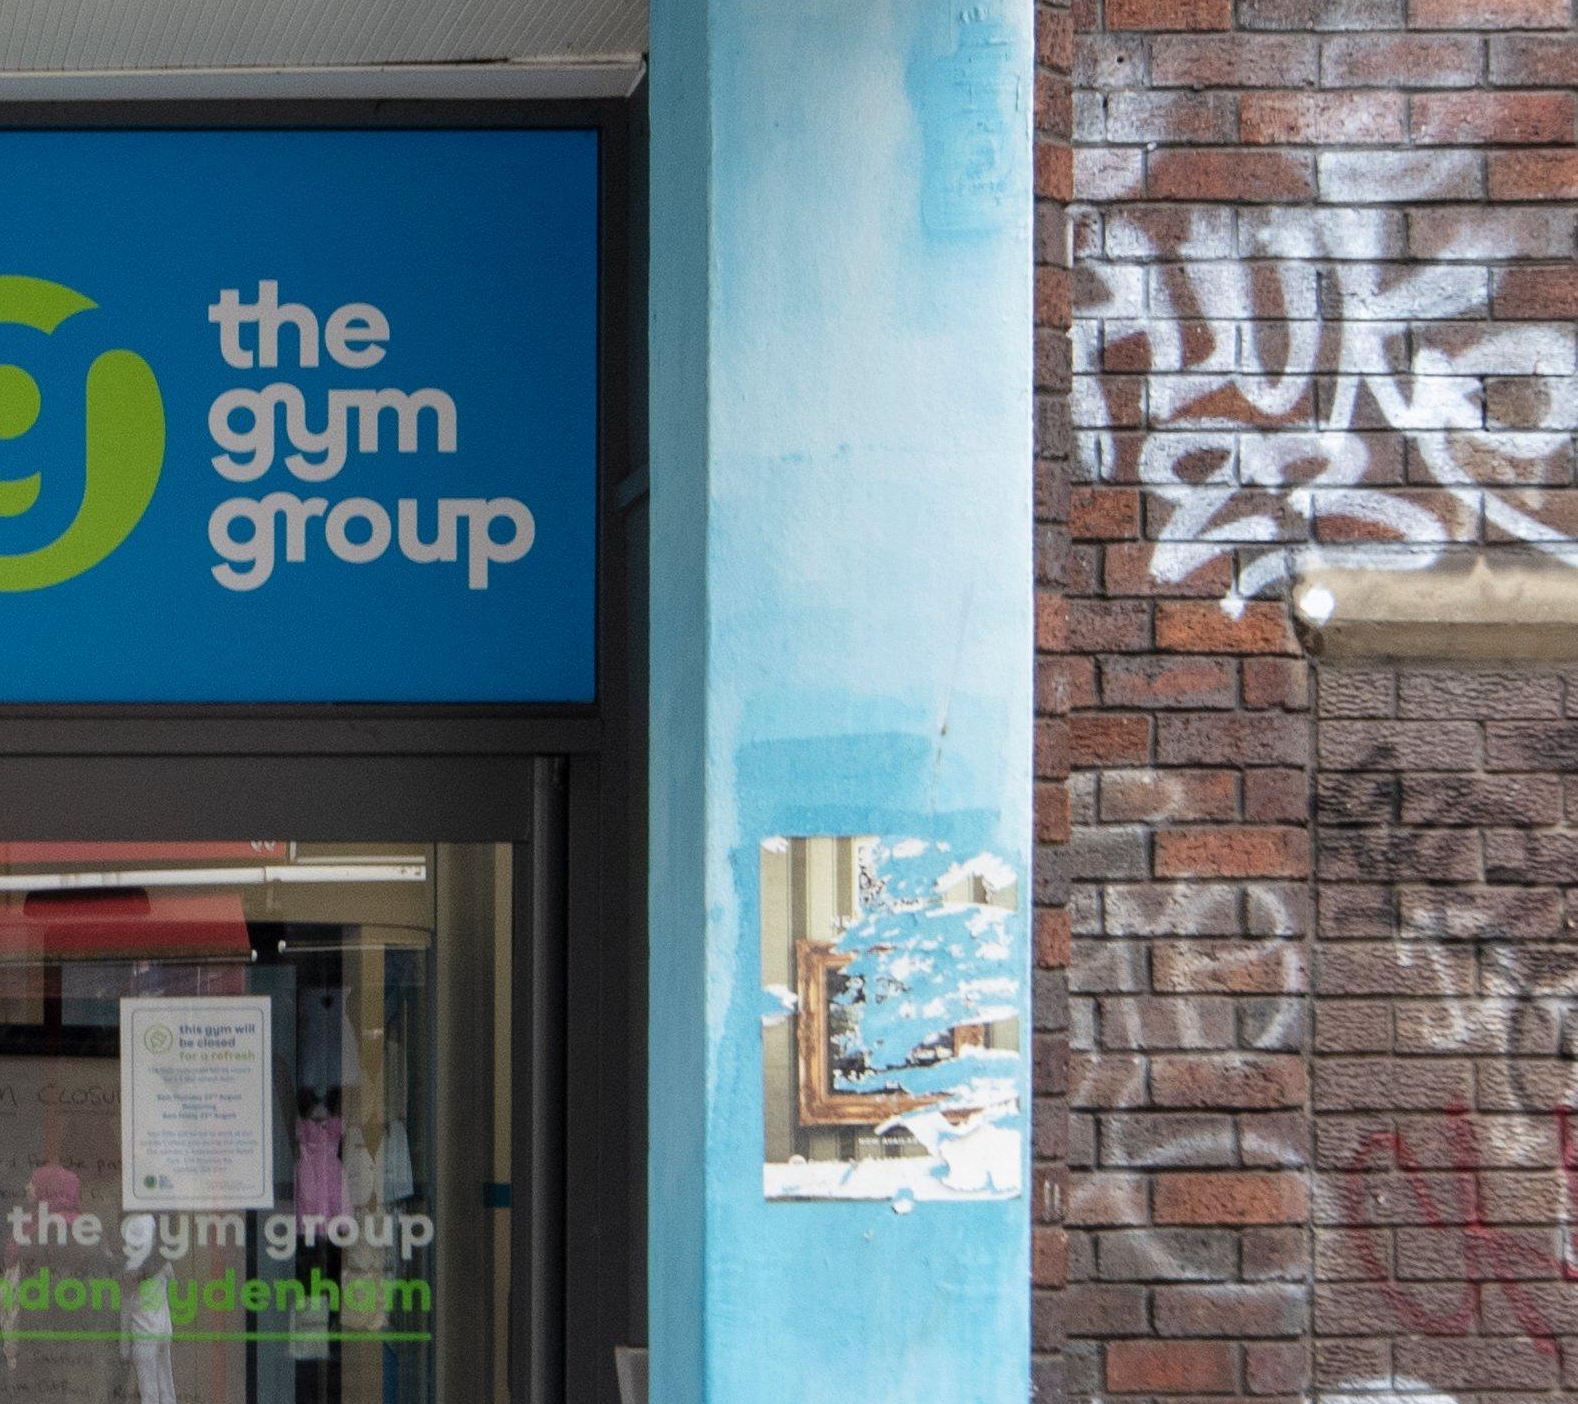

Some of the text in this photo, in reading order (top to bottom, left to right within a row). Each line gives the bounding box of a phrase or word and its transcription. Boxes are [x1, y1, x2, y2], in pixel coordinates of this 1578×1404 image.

[208, 280, 391, 369] the
[208, 382, 458, 483] gym
[208, 491, 536, 592] group
[179, 1024, 256, 1036] this gym will
[179, 1037, 236, 1047] be closed
[179, 1051, 197, 1060] for
[211, 1051, 256, 1060] refresh
[37, 1084, 121, 1108] CLOSU
[7, 1202, 102, 1247] the
[122, 1213, 245, 1260] gym
[265, 1213, 435, 1260] group
[139, 1268, 432, 1324] sydenham
